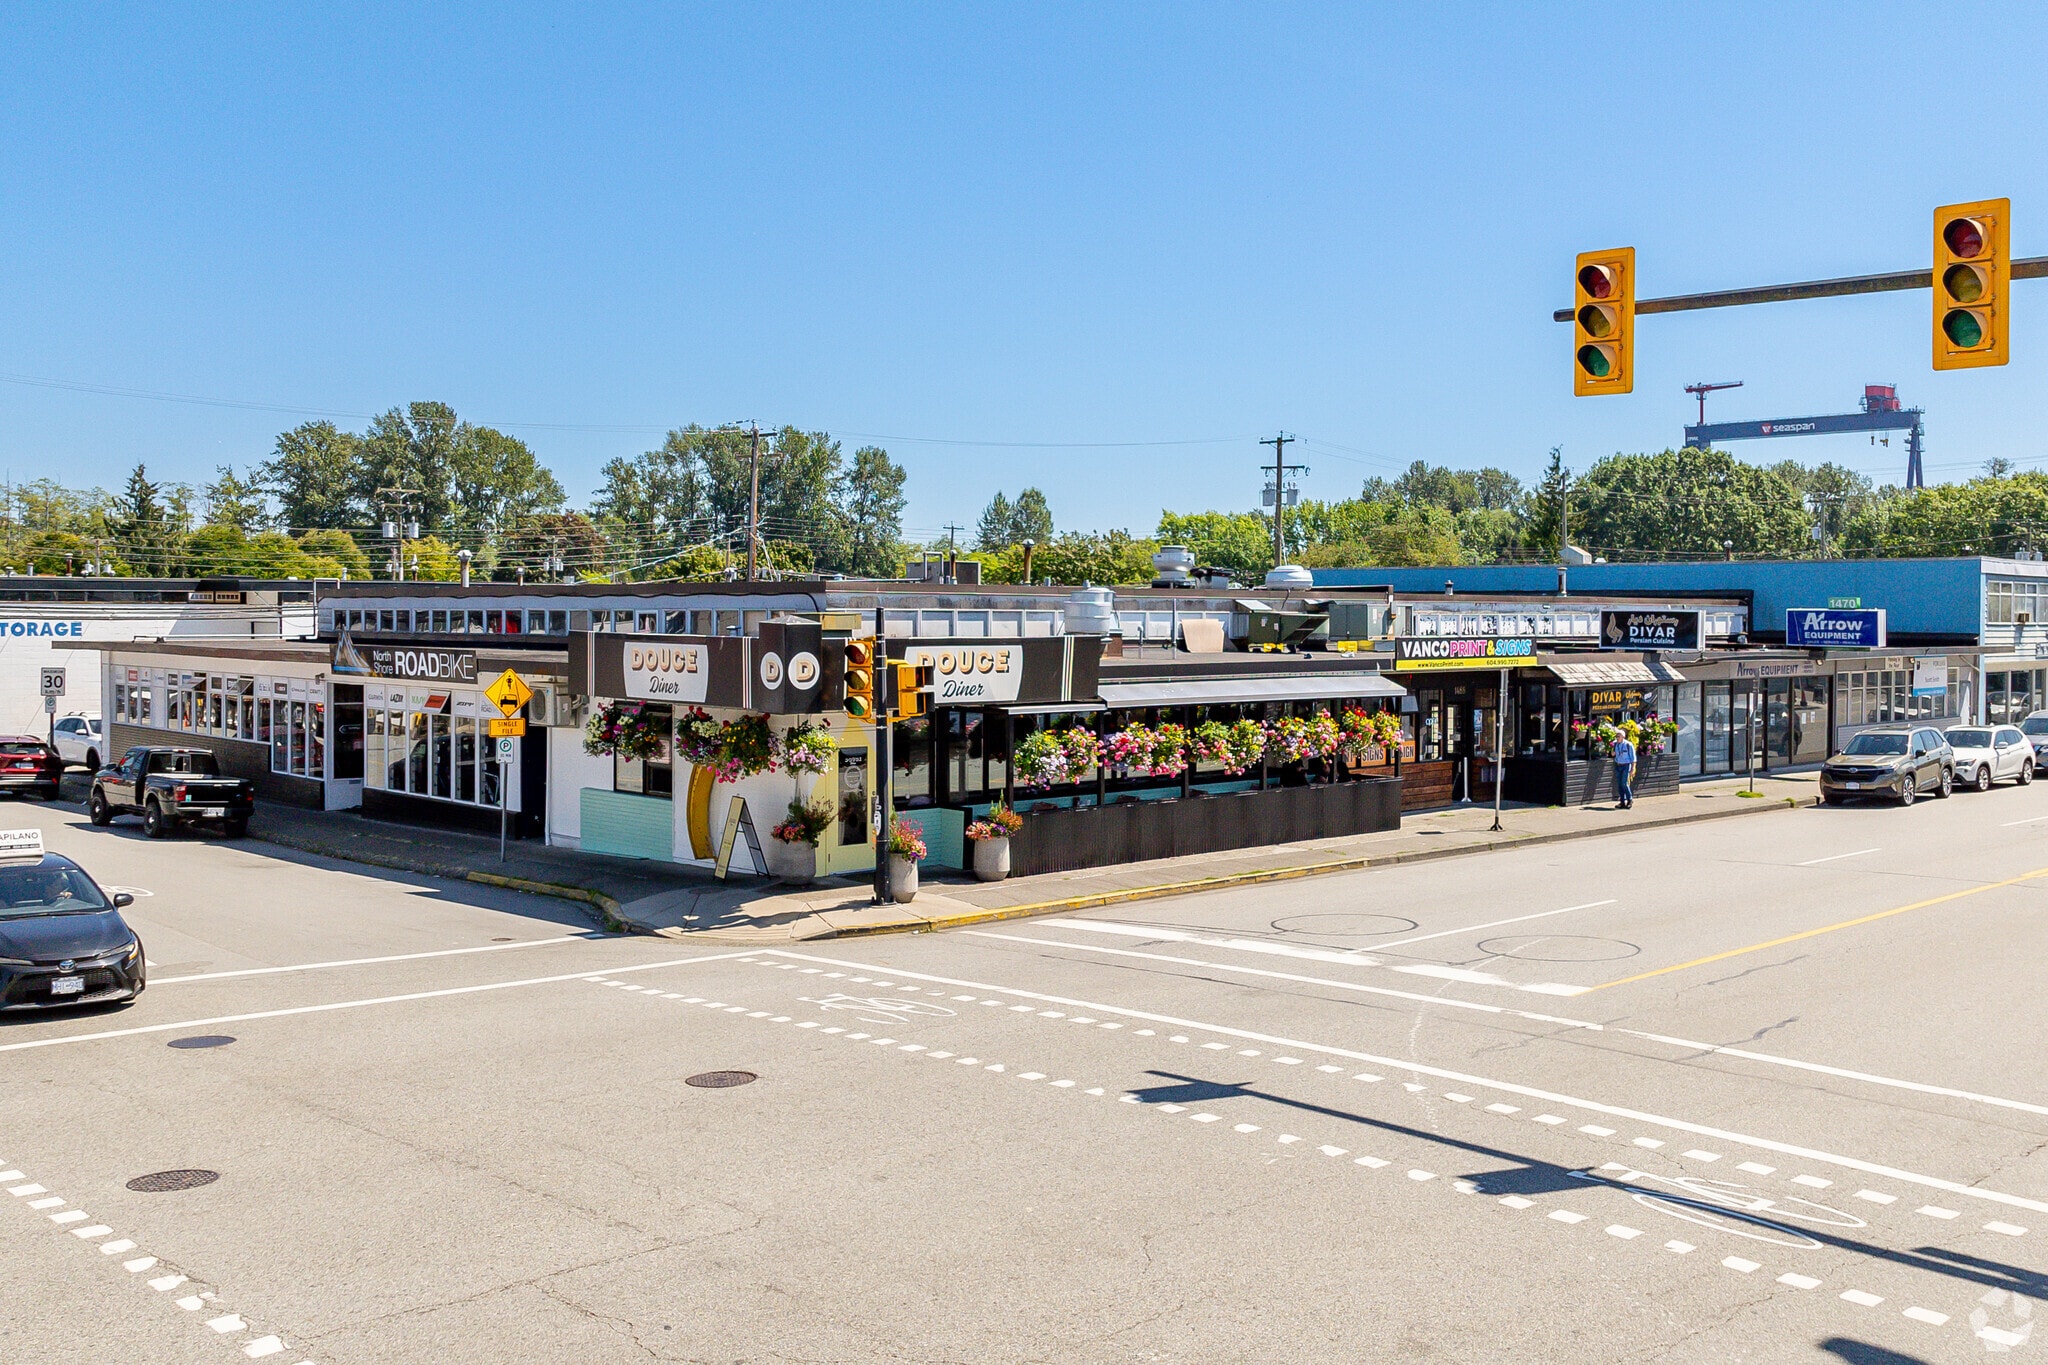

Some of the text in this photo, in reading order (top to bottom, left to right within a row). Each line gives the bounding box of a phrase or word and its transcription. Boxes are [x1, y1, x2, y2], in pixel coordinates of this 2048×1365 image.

[1773, 422, 1816, 433] seaspan
[1829, 599, 1856, 609] 1470
[1803, 612, 1863, 631] Arrow
[1629, 626, 1675, 638] DIYAR
[1804, 631, 1862, 640] EQUIPMENT
[1652, 637, 1675, 645] Cuisine
[373, 651, 392, 662] North
[631, 648, 698, 674] DOUCE
[916, 650, 1010, 675] DOUCE
[373, 661, 393, 674] Shore
[765, 661, 780, 682] D
[796, 659, 815, 682] D
[1760, 664, 1799, 676] EQUIPMENT
[44, 675, 63, 688] 30
[649, 675, 680, 694] Diner
[942, 679, 985, 698] Diner
[1592, 691, 1622, 704] DIYAR
[503, 742, 509, 750] P
[1362, 746, 1384, 762] SIGNS
